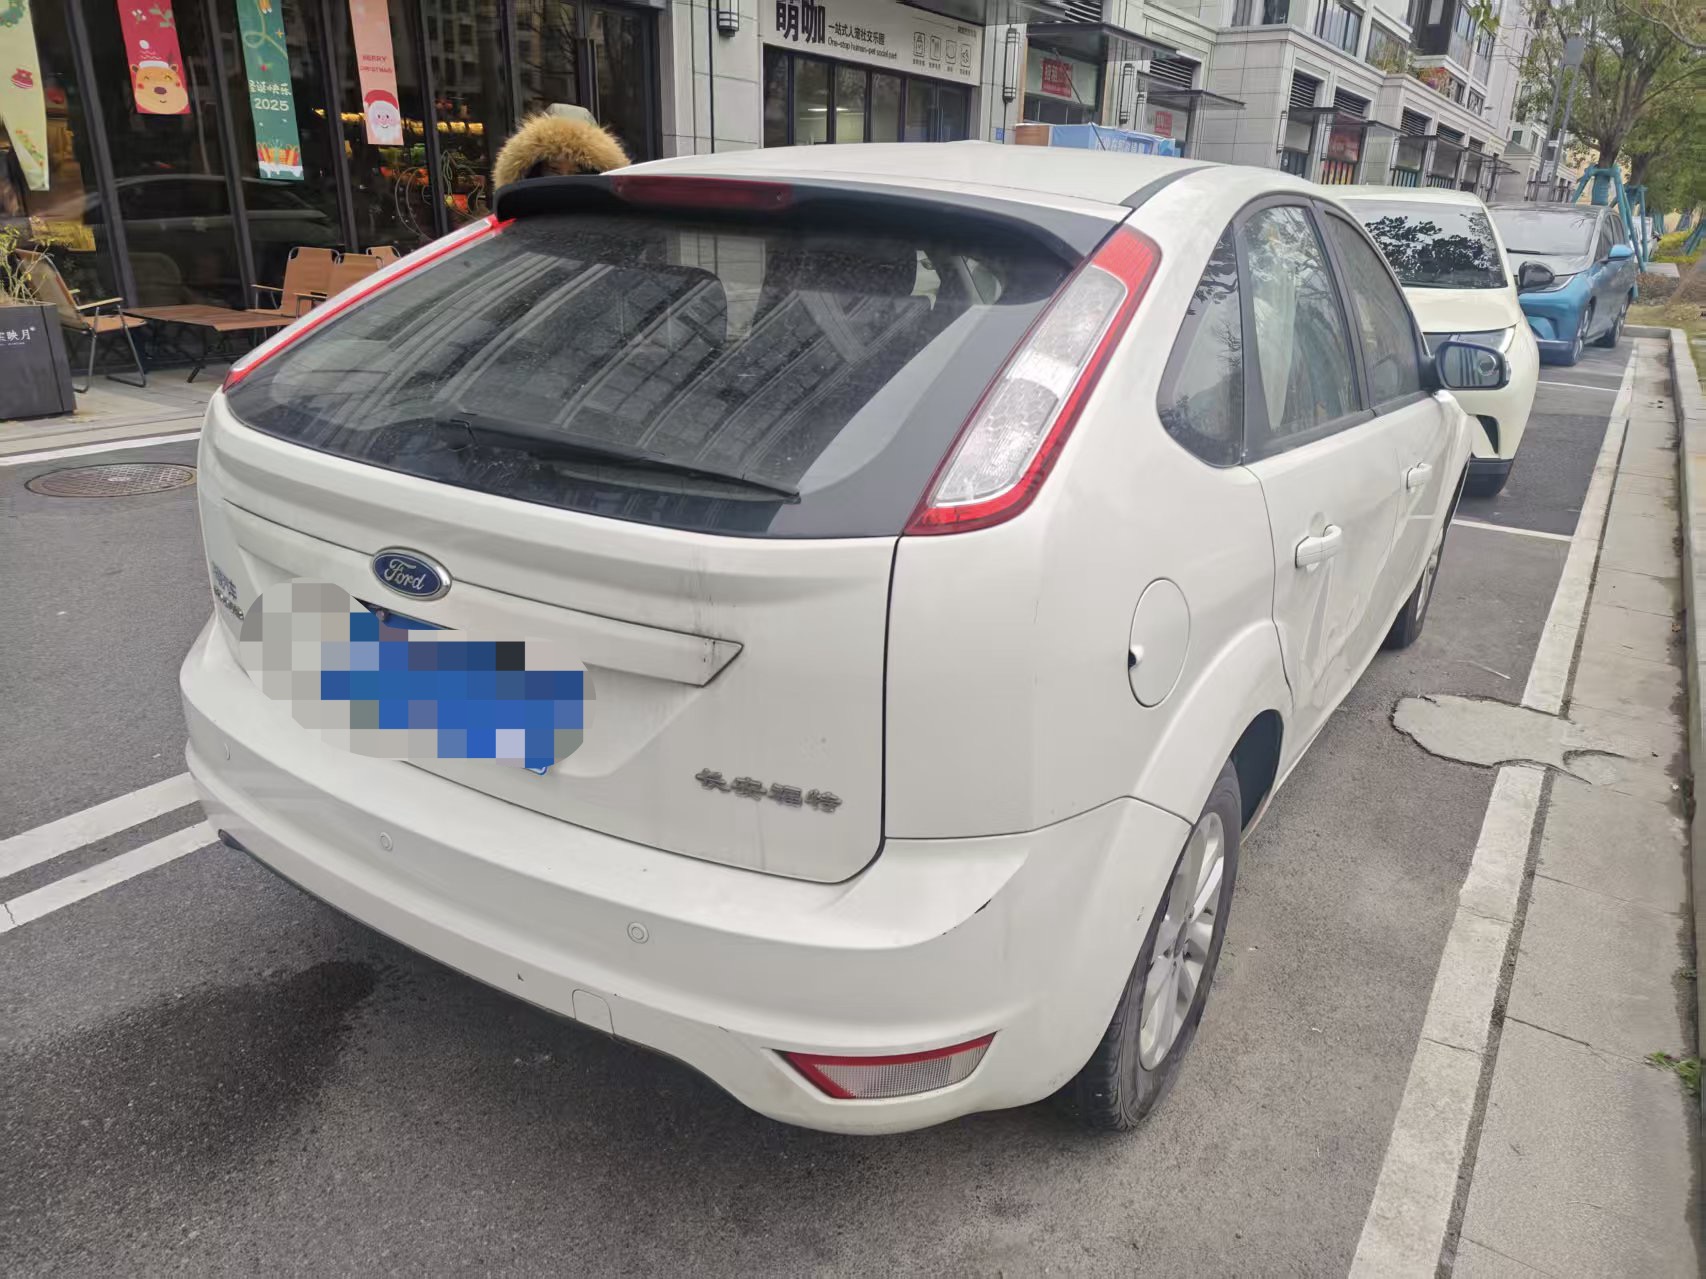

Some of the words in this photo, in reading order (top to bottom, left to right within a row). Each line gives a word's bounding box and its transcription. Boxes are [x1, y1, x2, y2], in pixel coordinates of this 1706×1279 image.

[827, 21, 886, 46] 一站式人宠社交乐园
[827, 36, 851, 50] One-stop
[248, 79, 292, 96] 圣诞快乐
[254, 97, 290, 111] 2025
[383, 558, 427, 590] Ford
